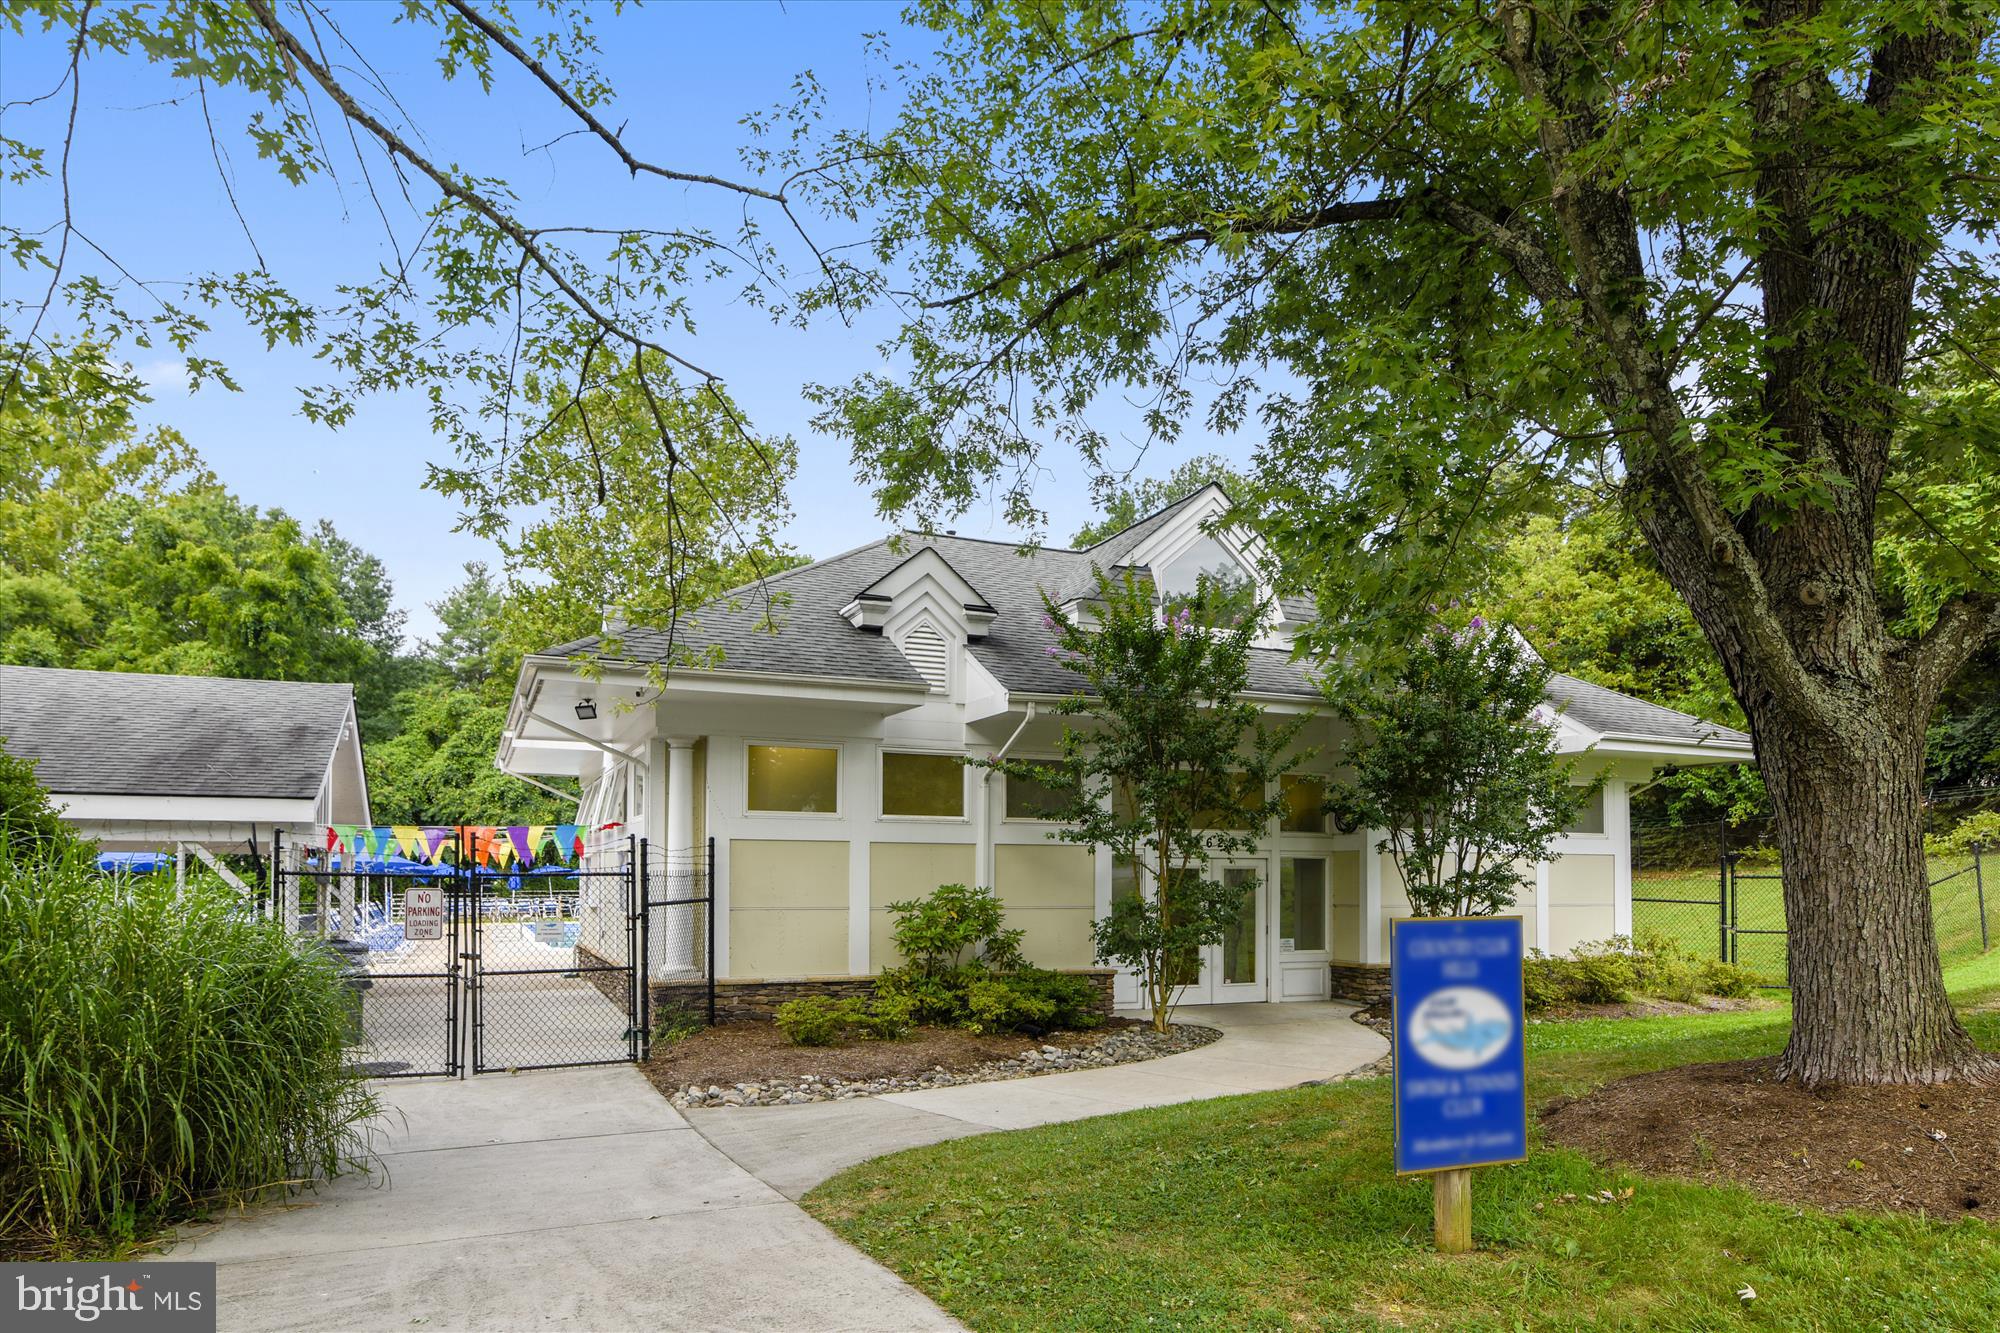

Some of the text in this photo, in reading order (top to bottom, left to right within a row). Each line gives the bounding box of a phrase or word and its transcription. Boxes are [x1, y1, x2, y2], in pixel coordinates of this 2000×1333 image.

[417, 893, 432, 904] NO
[408, 906, 441, 917] PARKING
[409, 919, 439, 927] LOADING
[414, 928, 434, 936] ZONE
